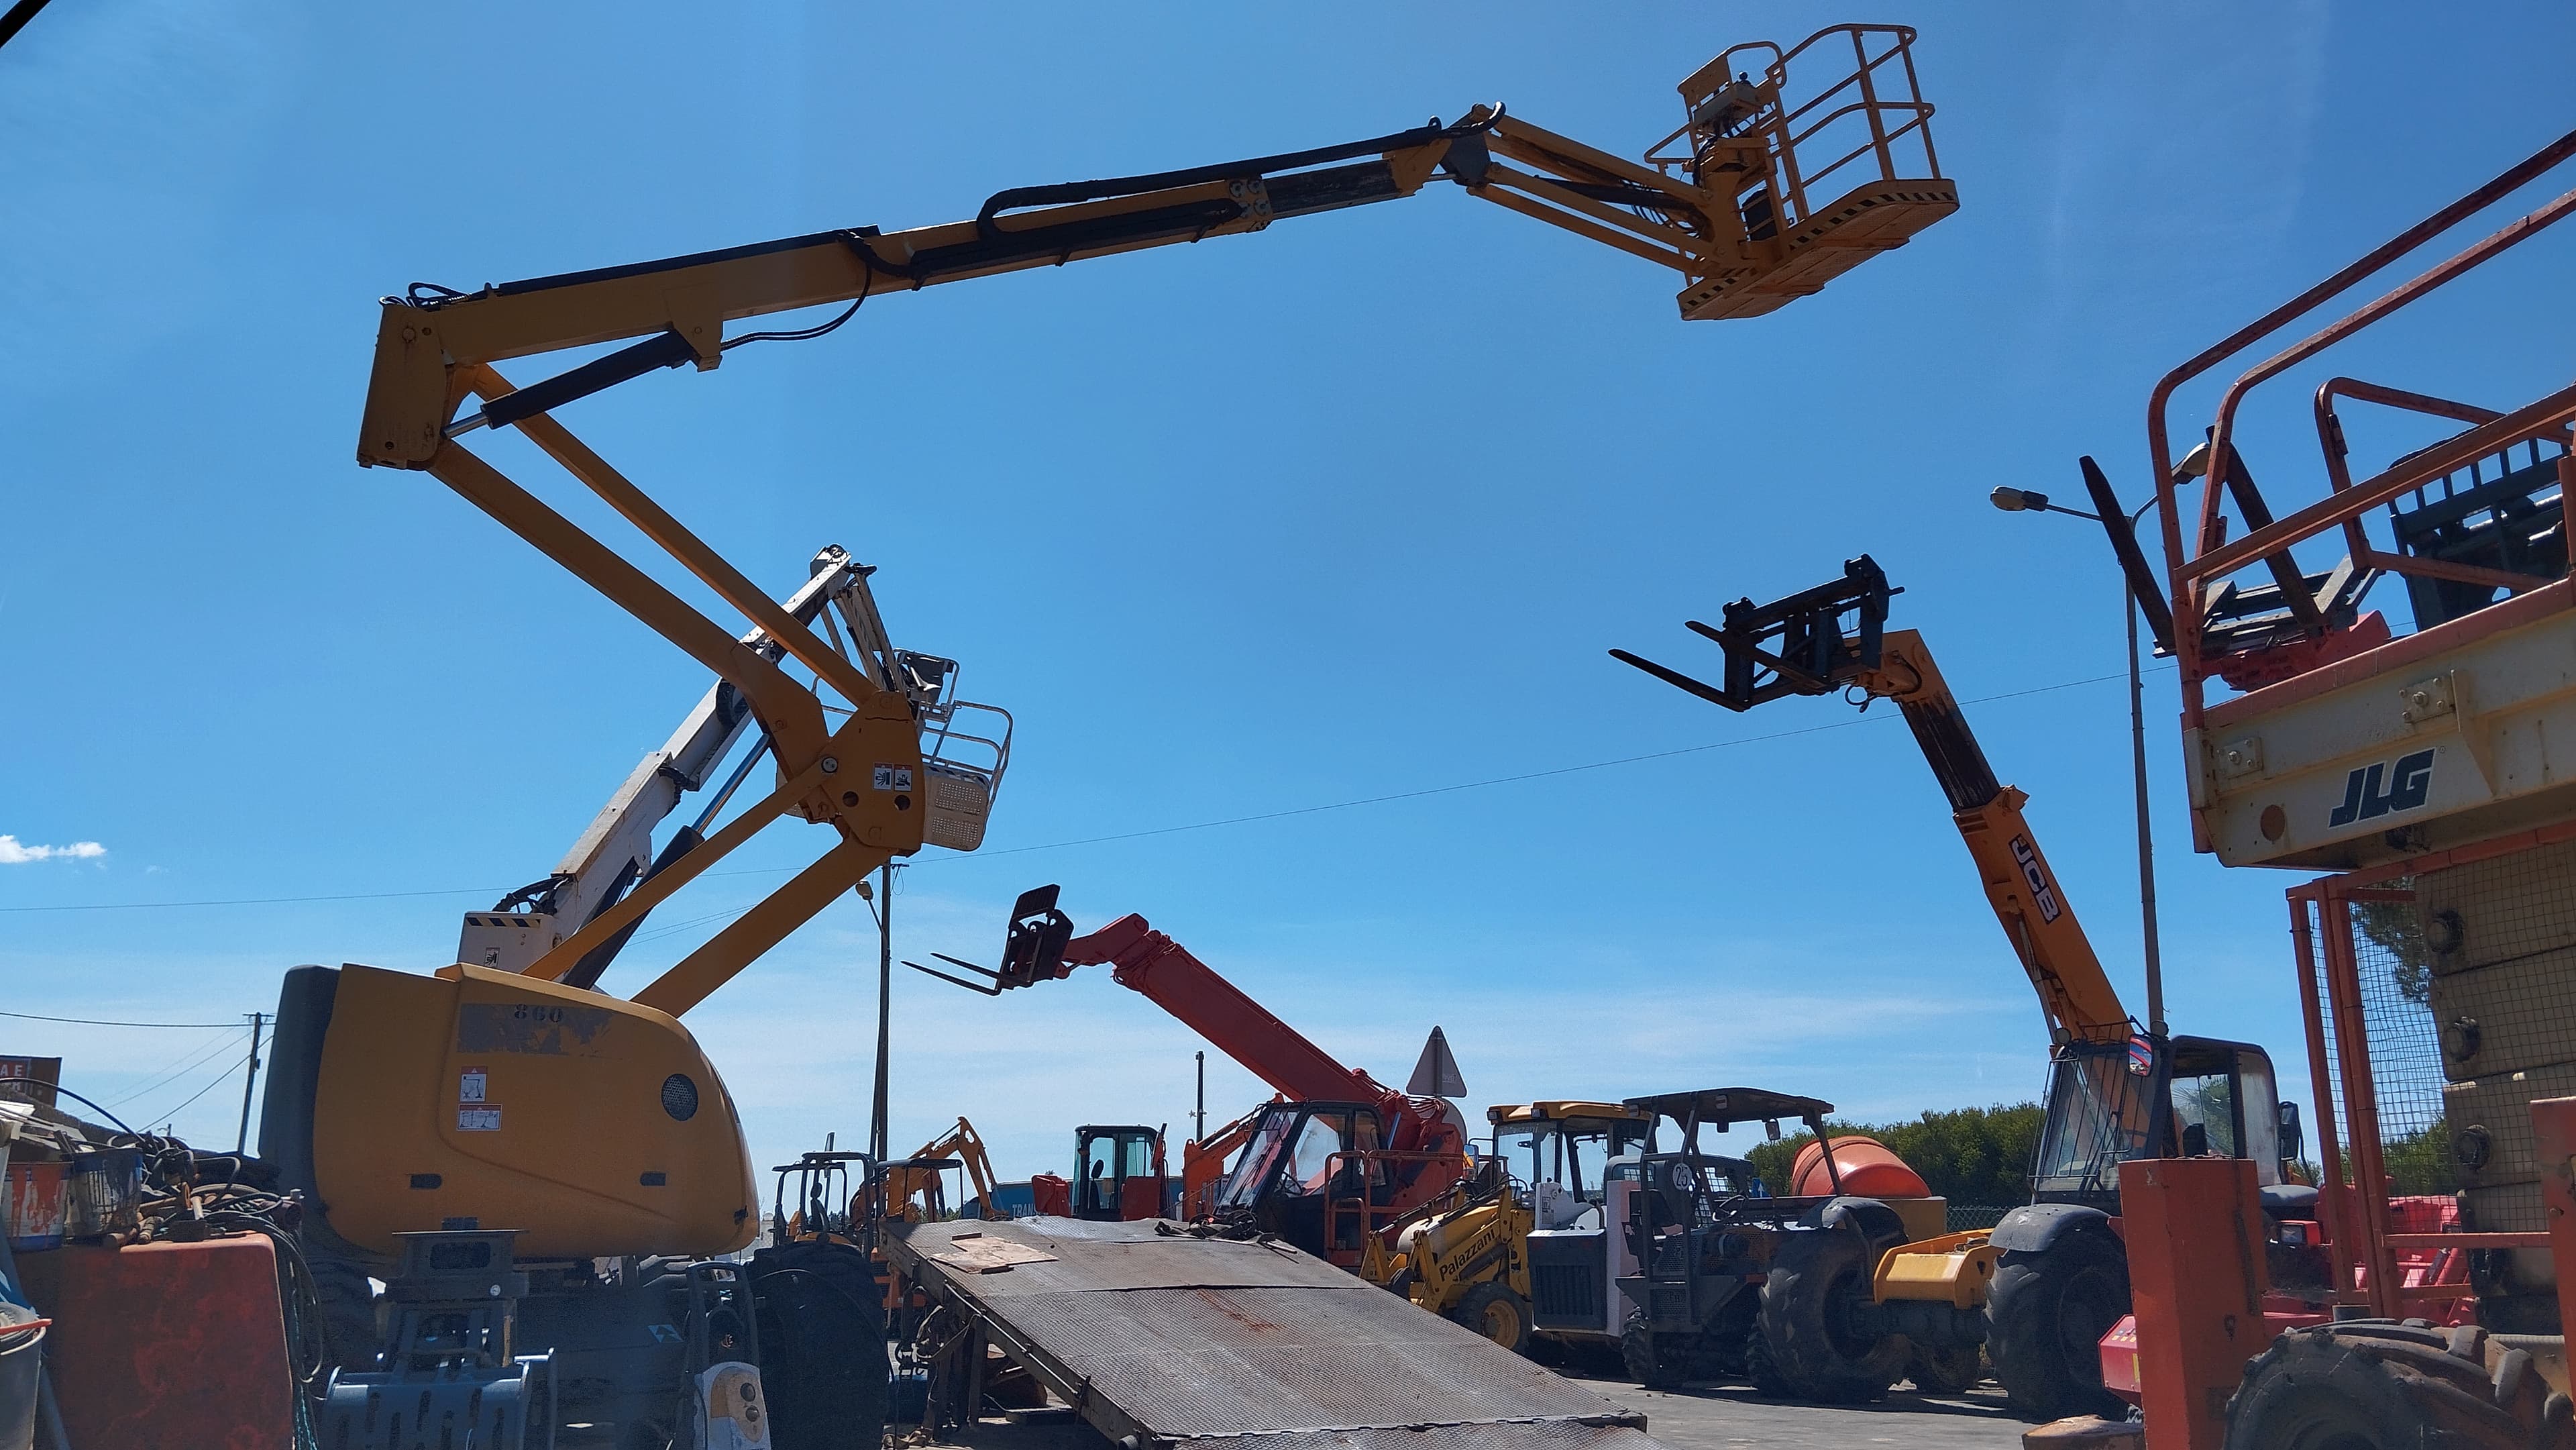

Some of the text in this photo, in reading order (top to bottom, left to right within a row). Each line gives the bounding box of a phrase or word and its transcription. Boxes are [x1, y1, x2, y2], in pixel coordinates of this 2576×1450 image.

[2328, 747, 2436, 829] JLG
[2012, 839, 2059, 921] JCB
[1676, 1166, 1688, 1187] 25
[1439, 1228, 1495, 1282] Palazzani
